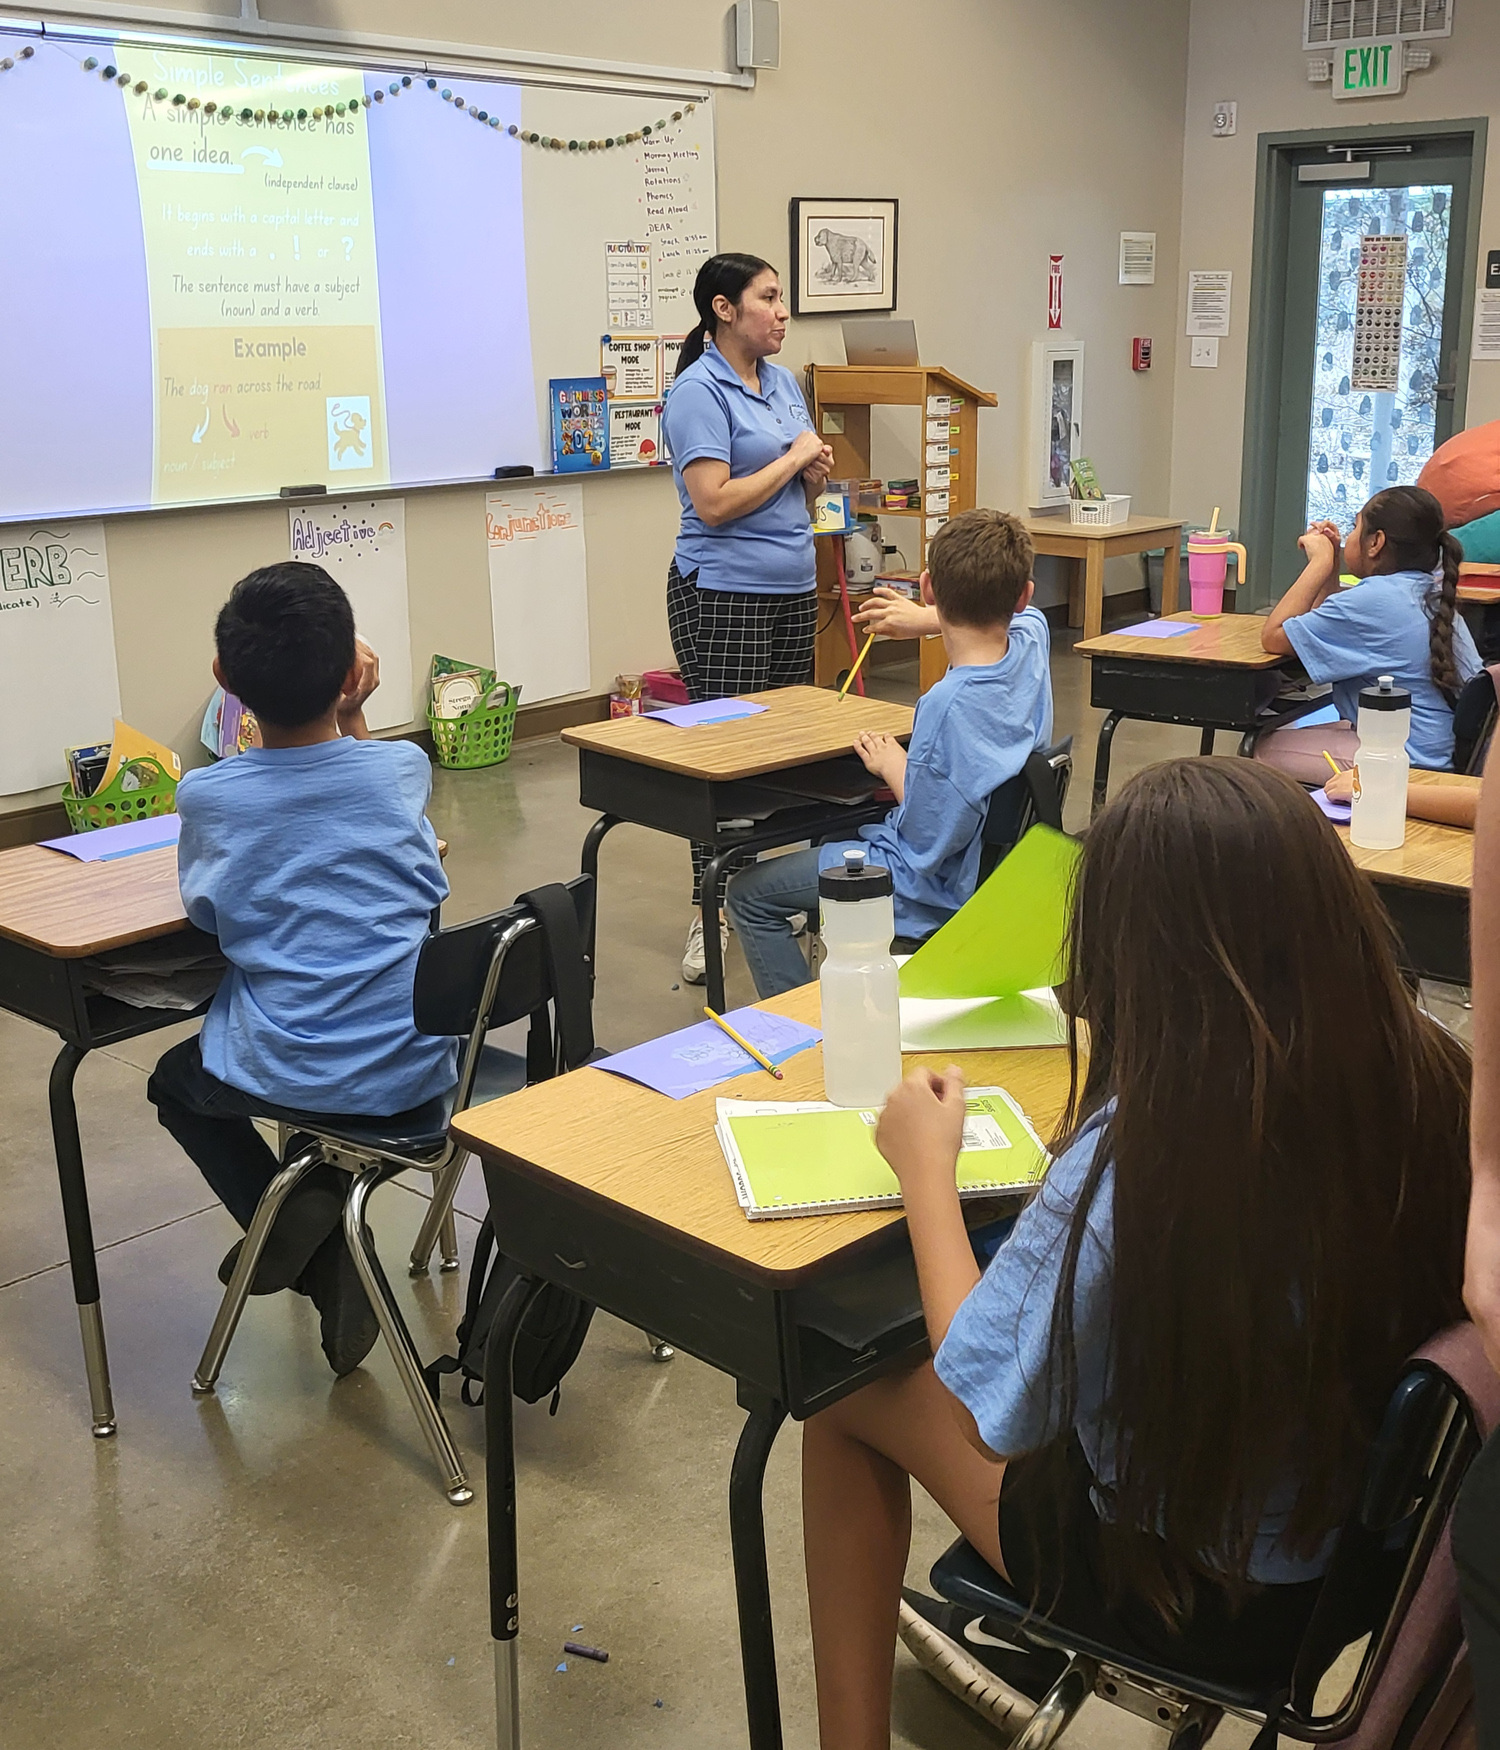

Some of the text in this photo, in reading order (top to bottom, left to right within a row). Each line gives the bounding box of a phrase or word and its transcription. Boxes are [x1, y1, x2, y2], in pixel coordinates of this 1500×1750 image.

[153, 52, 340, 96] Simple Sentences
[1344, 45, 1392, 89] EXIT
[142, 92, 156, 122] A
[325, 112, 355, 135] has
[664, 135, 675, 145] Up
[150, 136, 234, 165] one idea.
[264, 172, 359, 195] (independent clause)
[644, 178, 681, 187] Rotations
[646, 191, 674, 202] Phonics
[162, 203, 360, 232] It begins with a capital letter and
[647, 205, 689, 216] Read Aloud
[648, 223, 673, 233] DEAR
[186, 238, 215, 257] ends
[219, 239, 245, 257] with
[249, 247, 258, 257] a
[293, 234, 301, 261] !
[317, 247, 329, 258] or
[341, 235, 355, 262] ?
[607, 244, 650, 253] PUNCTUATION
[1052, 265, 1061, 274] FIRE
[172, 274, 360, 301] The sentence must have a subject
[221, 298, 255, 317] (noun)
[260, 298, 280, 317] and
[284, 306, 291, 317] a
[234, 336, 307, 362] Example
[608, 342, 651, 352] COFFEE SHOP
[621, 355, 640, 364] MODE
[164, 377, 185, 397] The
[189, 377, 209, 405] dog
[213, 383, 232, 394] ran
[236, 382, 272, 394] across
[276, 373, 293, 393] the
[558, 390, 605, 404] GUINNESS
[560, 403, 604, 419] WORLD
[615, 409, 653, 420] RESTAURANT
[249, 422, 269, 440] verb
[561, 417, 605, 431] RECORDS
[625, 421, 641, 431] MODE
[561, 428, 607, 456] 2025
[163, 461, 188, 473] noun
[202, 450, 236, 480] subject
[485, 503, 572, 541] Conjunctions
[293, 518, 376, 558] Adjective
[0, 595, 40, 611] icate)
